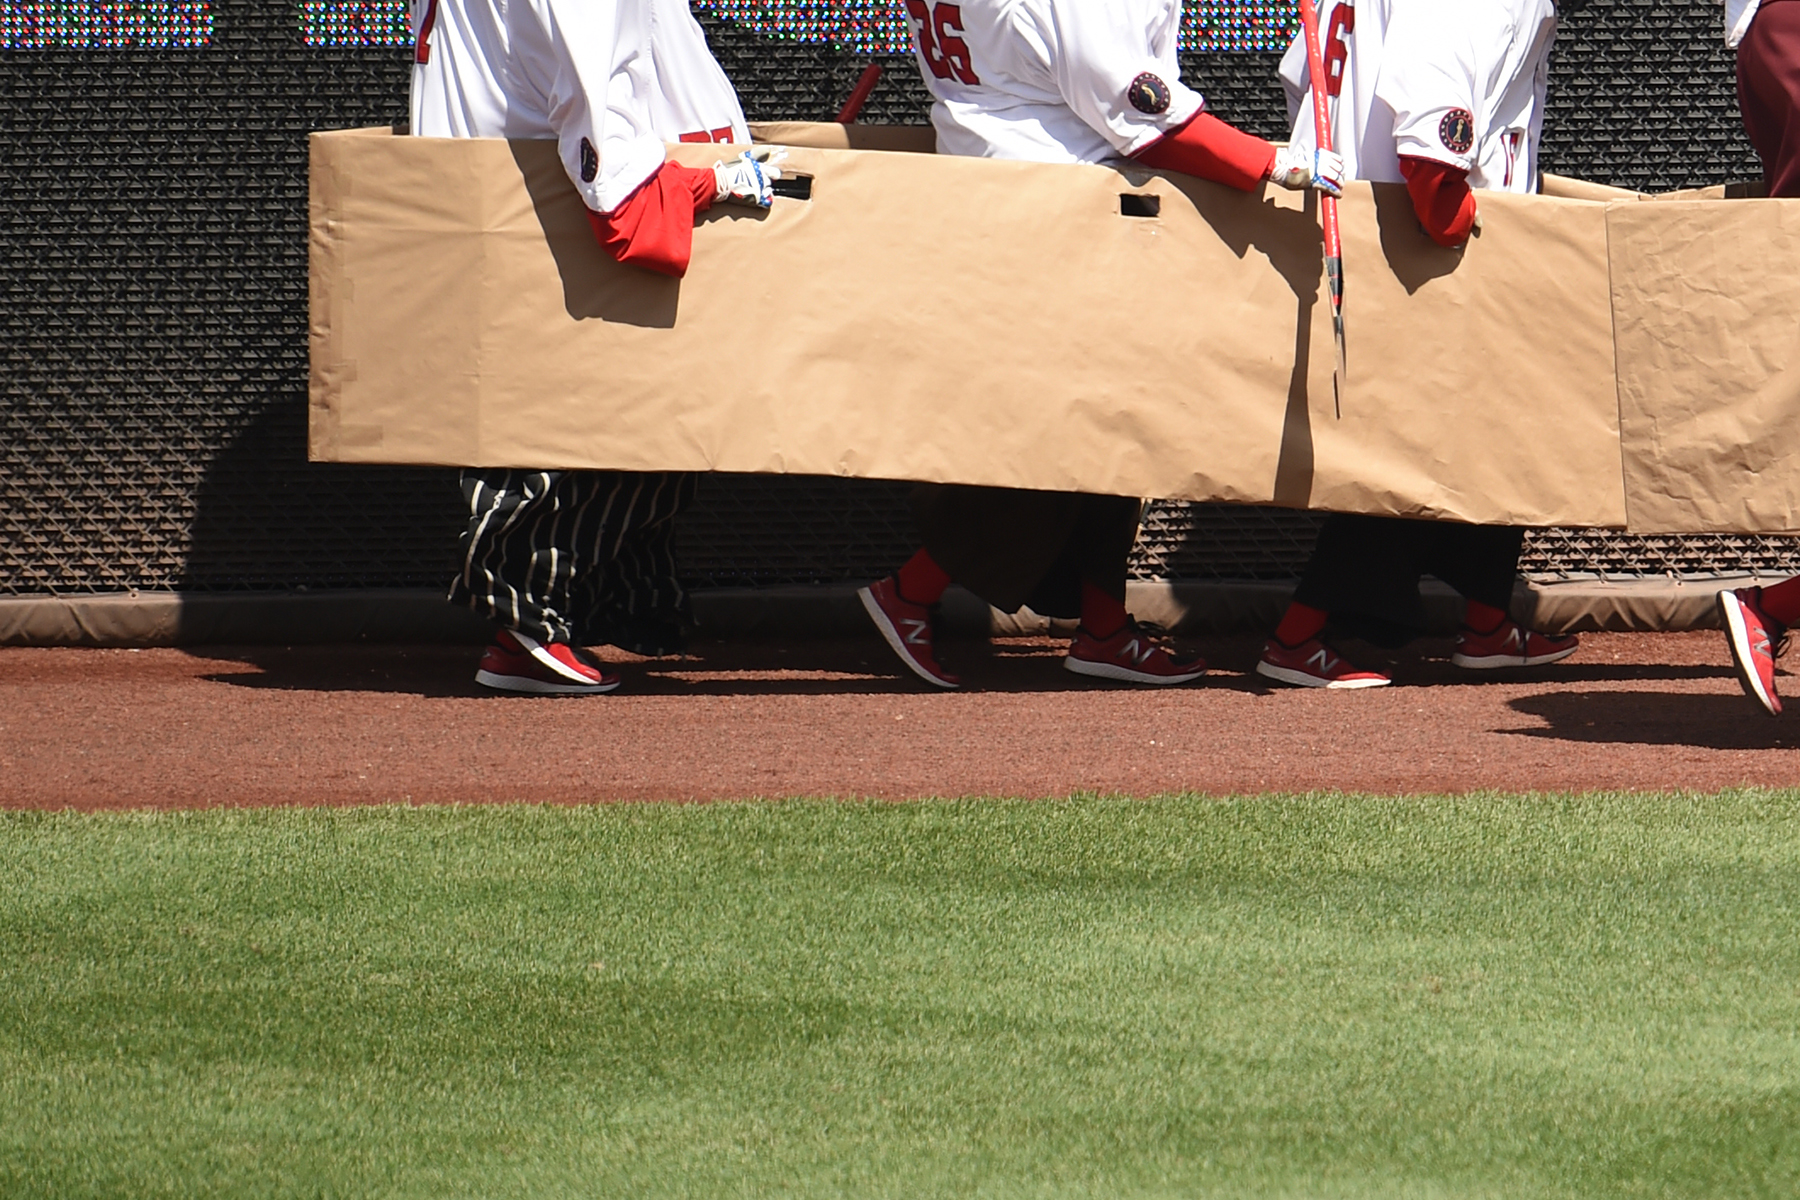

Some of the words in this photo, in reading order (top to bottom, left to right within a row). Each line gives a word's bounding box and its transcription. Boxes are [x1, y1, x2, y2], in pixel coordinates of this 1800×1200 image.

[900, 618, 929, 645] N
[1116, 639, 1156, 665] N
[1304, 649, 1339, 674] N
